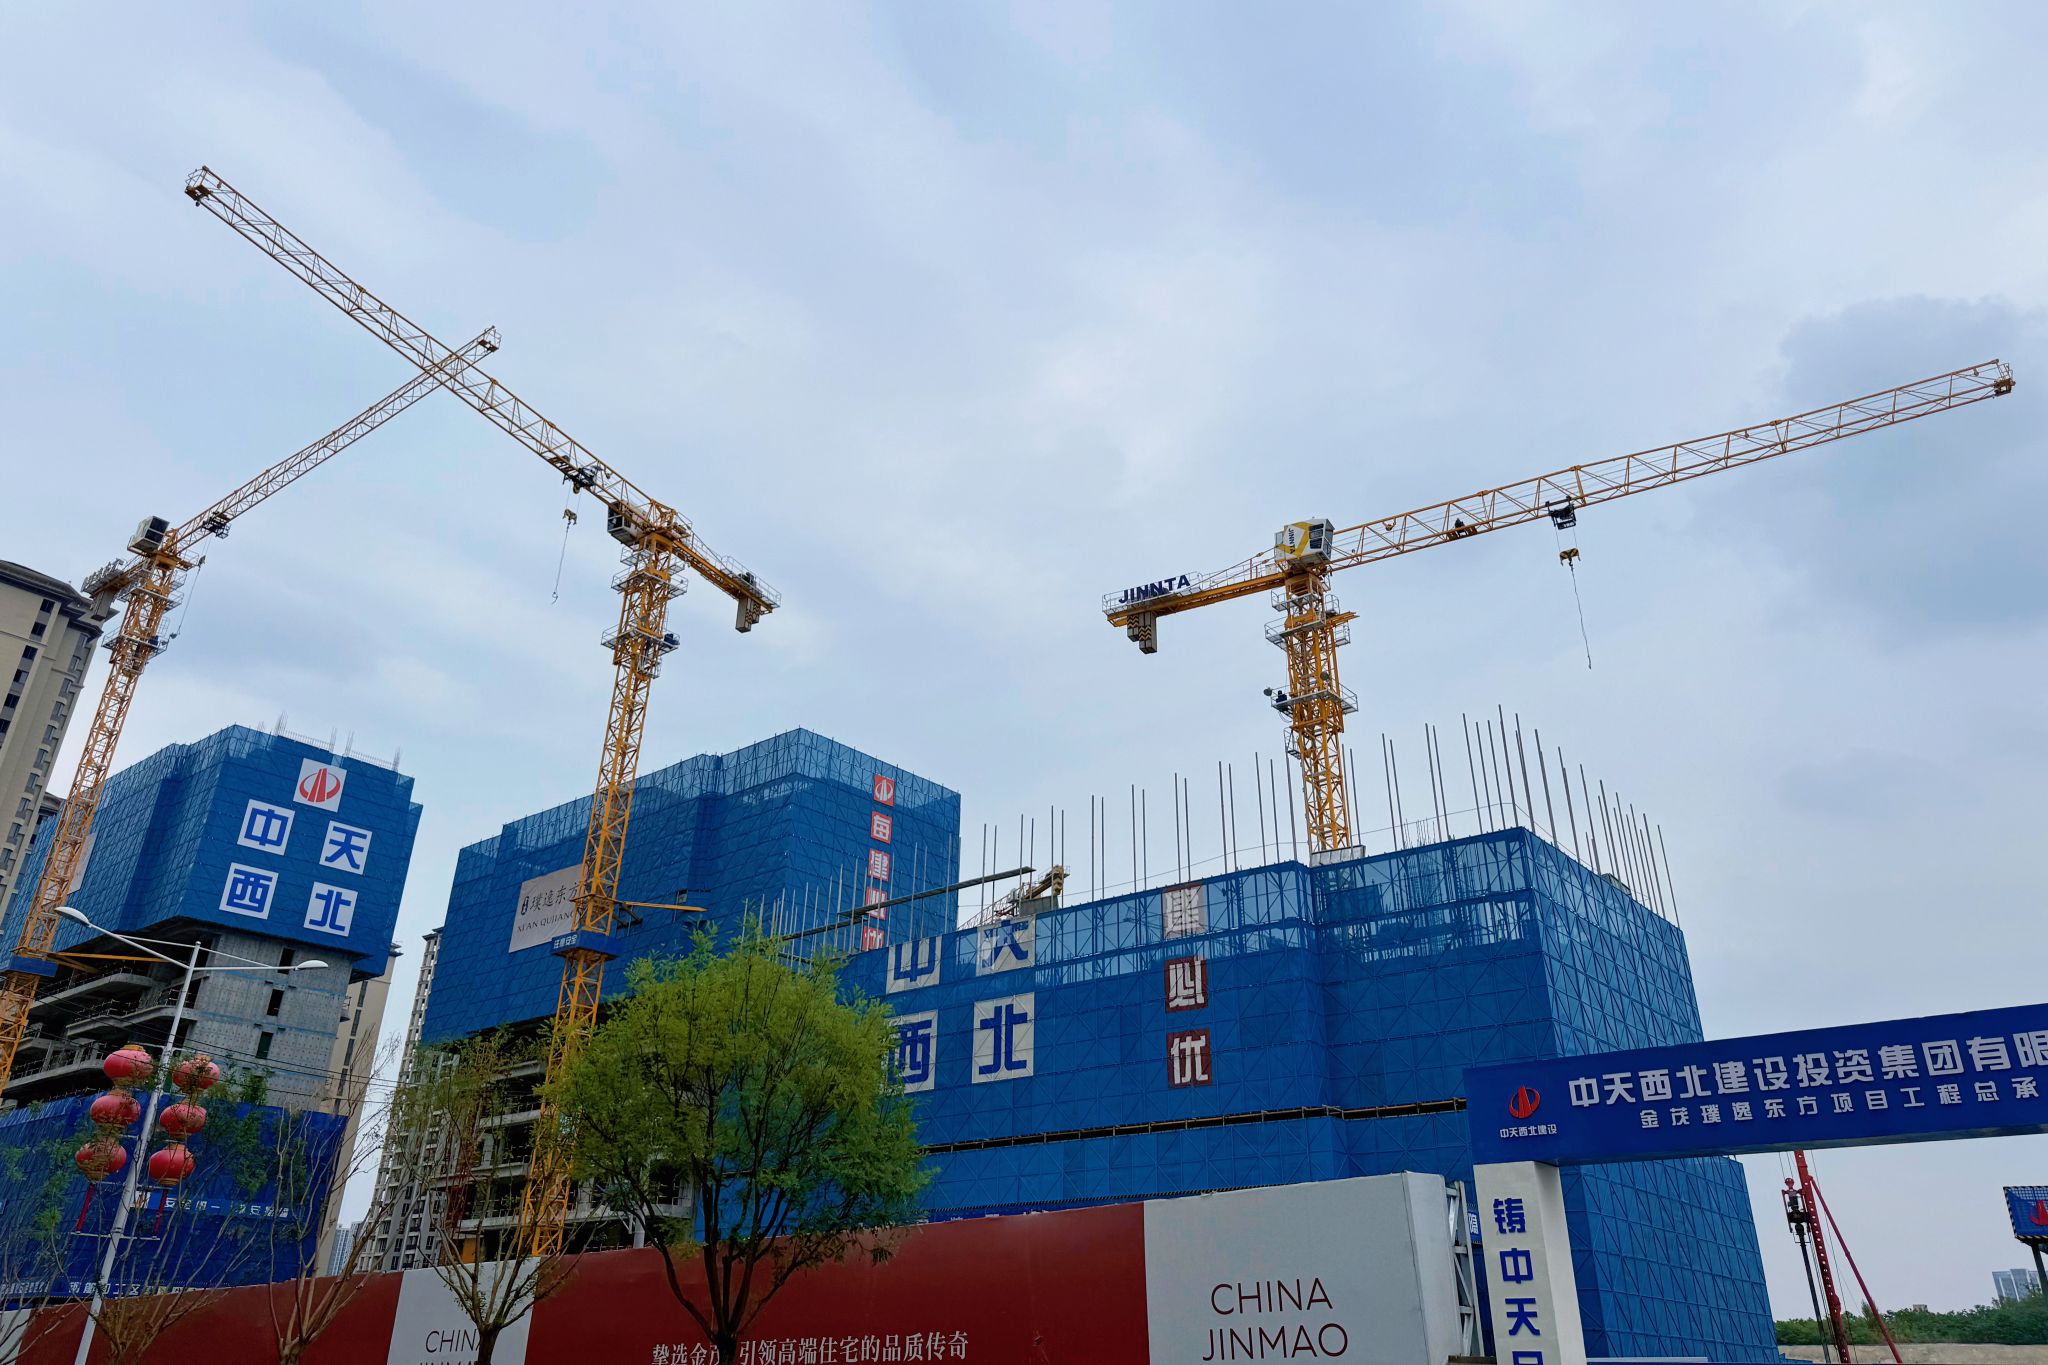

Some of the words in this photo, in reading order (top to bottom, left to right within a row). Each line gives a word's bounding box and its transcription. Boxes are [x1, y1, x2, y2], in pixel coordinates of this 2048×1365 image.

[1288, 528, 1296, 554] JINNTA
[1118, 574, 1191, 604] JINNTA
[244, 808, 368, 870] 中天
[226, 868, 352, 932] 西北
[888, 1003, 1028, 1085] 西北
[1499, 1123, 1558, 1139] 中天西北建设
[1210, 1277, 1333, 1316] CHINA
[425, 1328, 480, 1353] CHIN
[1202, 1322, 1349, 1361] JINMAO
